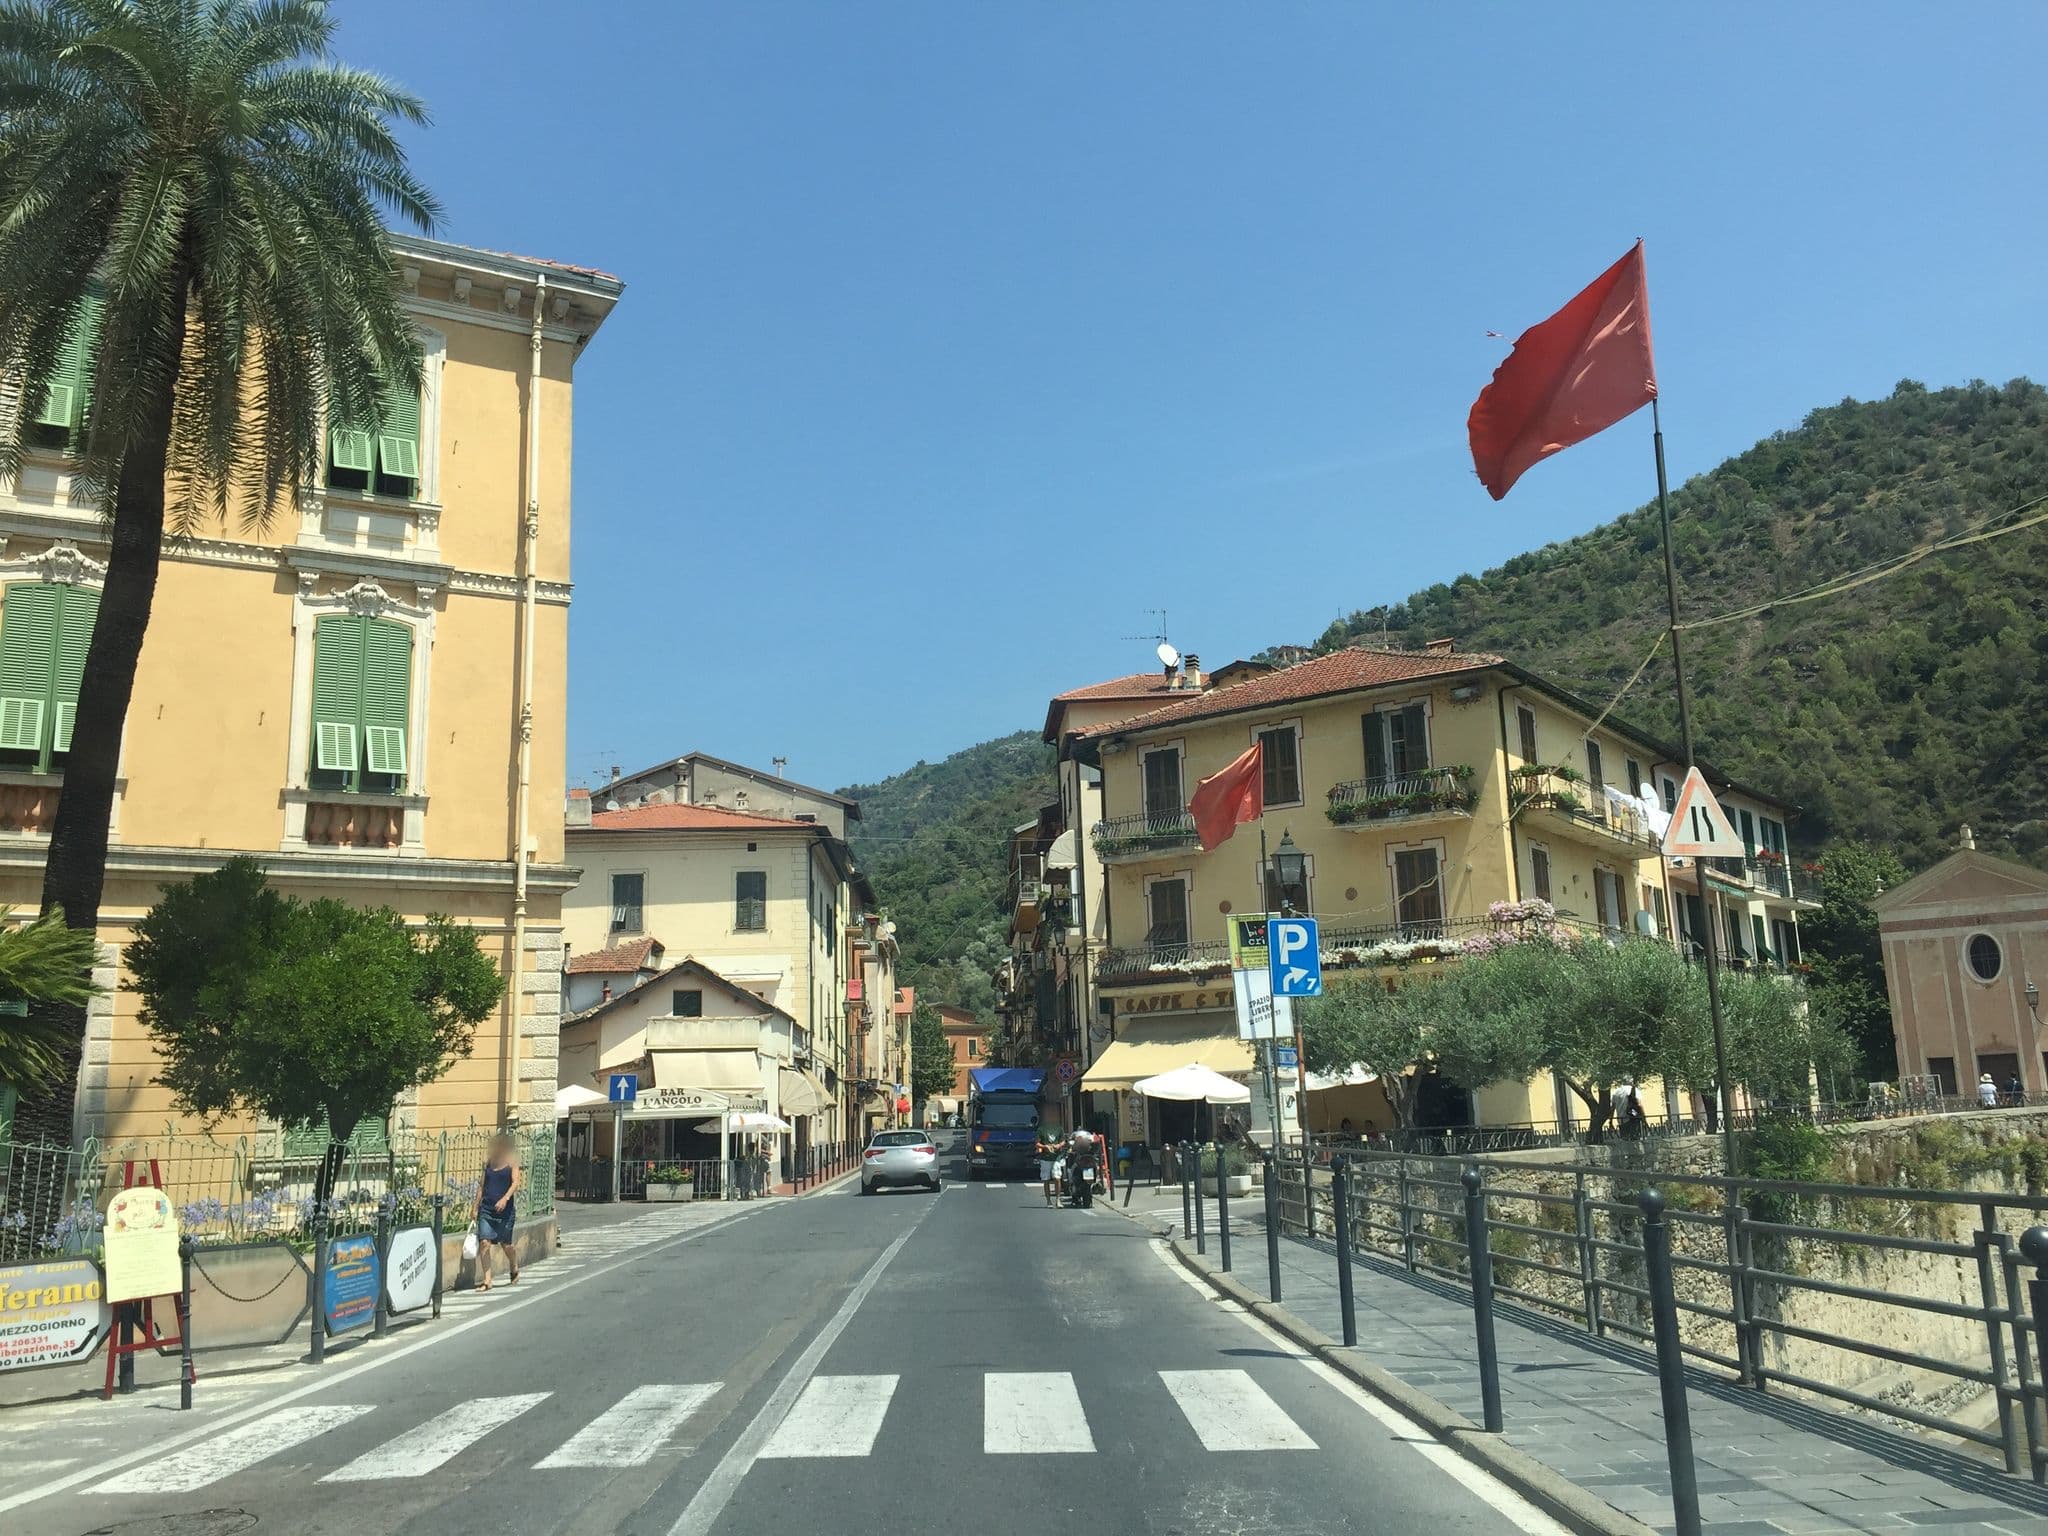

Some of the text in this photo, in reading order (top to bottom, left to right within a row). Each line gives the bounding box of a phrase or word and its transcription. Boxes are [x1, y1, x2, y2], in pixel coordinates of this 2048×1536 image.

[1278, 924, 1308, 964] P
[1307, 978, 1317, 990] 7
[1249, 995, 1270, 1008] SPAZIO
[660, 1088, 685, 1097] BAR
[643, 1096, 702, 1106] L'ANGOLO
[36, 1262, 86, 1273] Pizzeria
[0, 1318, 86, 1336] MEZZOGIORNO
[16, 1355, 45, 1364] ALLA
[50, 1351, 70, 1360] VIA
